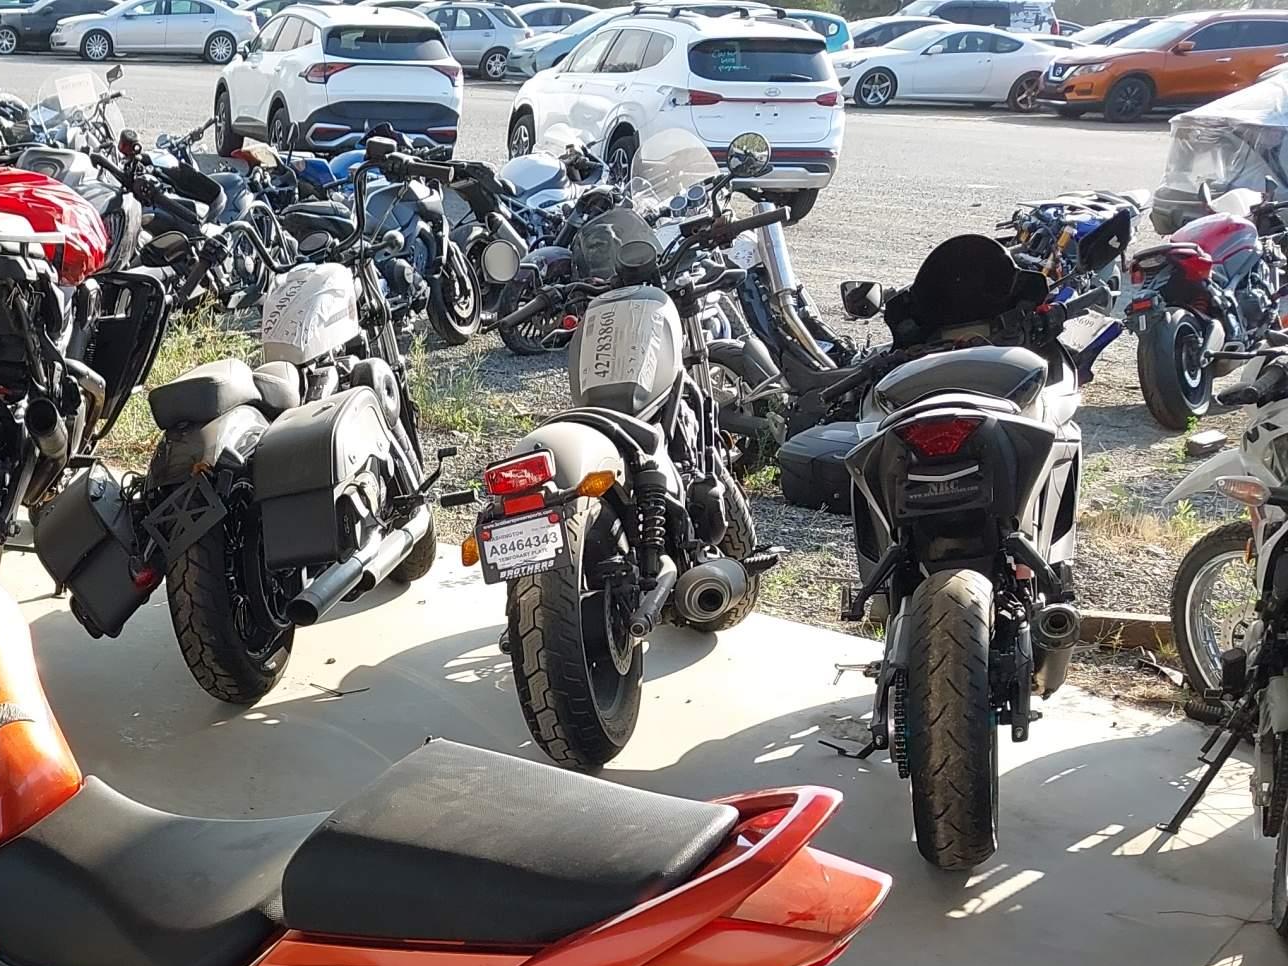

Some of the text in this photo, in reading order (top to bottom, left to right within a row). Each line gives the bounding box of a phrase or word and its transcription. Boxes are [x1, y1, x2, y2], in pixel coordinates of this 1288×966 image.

[593, 311, 616, 378] 42783860
[489, 532, 559, 558] A8464343
[499, 560, 555, 579] BROTHERS
